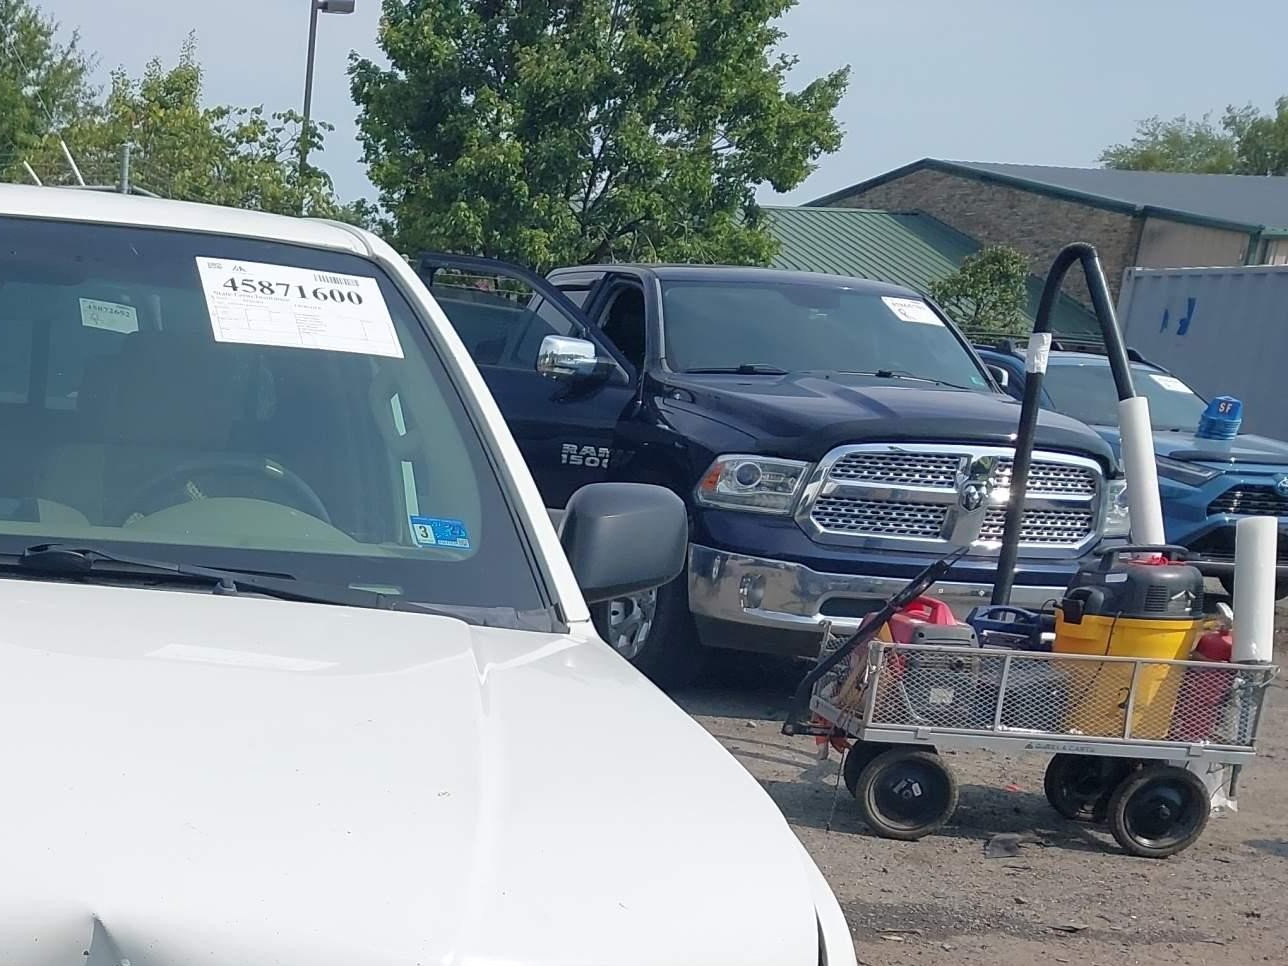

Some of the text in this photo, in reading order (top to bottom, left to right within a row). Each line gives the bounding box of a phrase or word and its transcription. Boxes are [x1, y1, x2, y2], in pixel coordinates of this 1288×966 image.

[222, 276, 364, 306] 45871600
[1218, 402, 1233, 413] SF
[561, 443, 610, 458] RAM
[419, 525, 429, 539] 3
